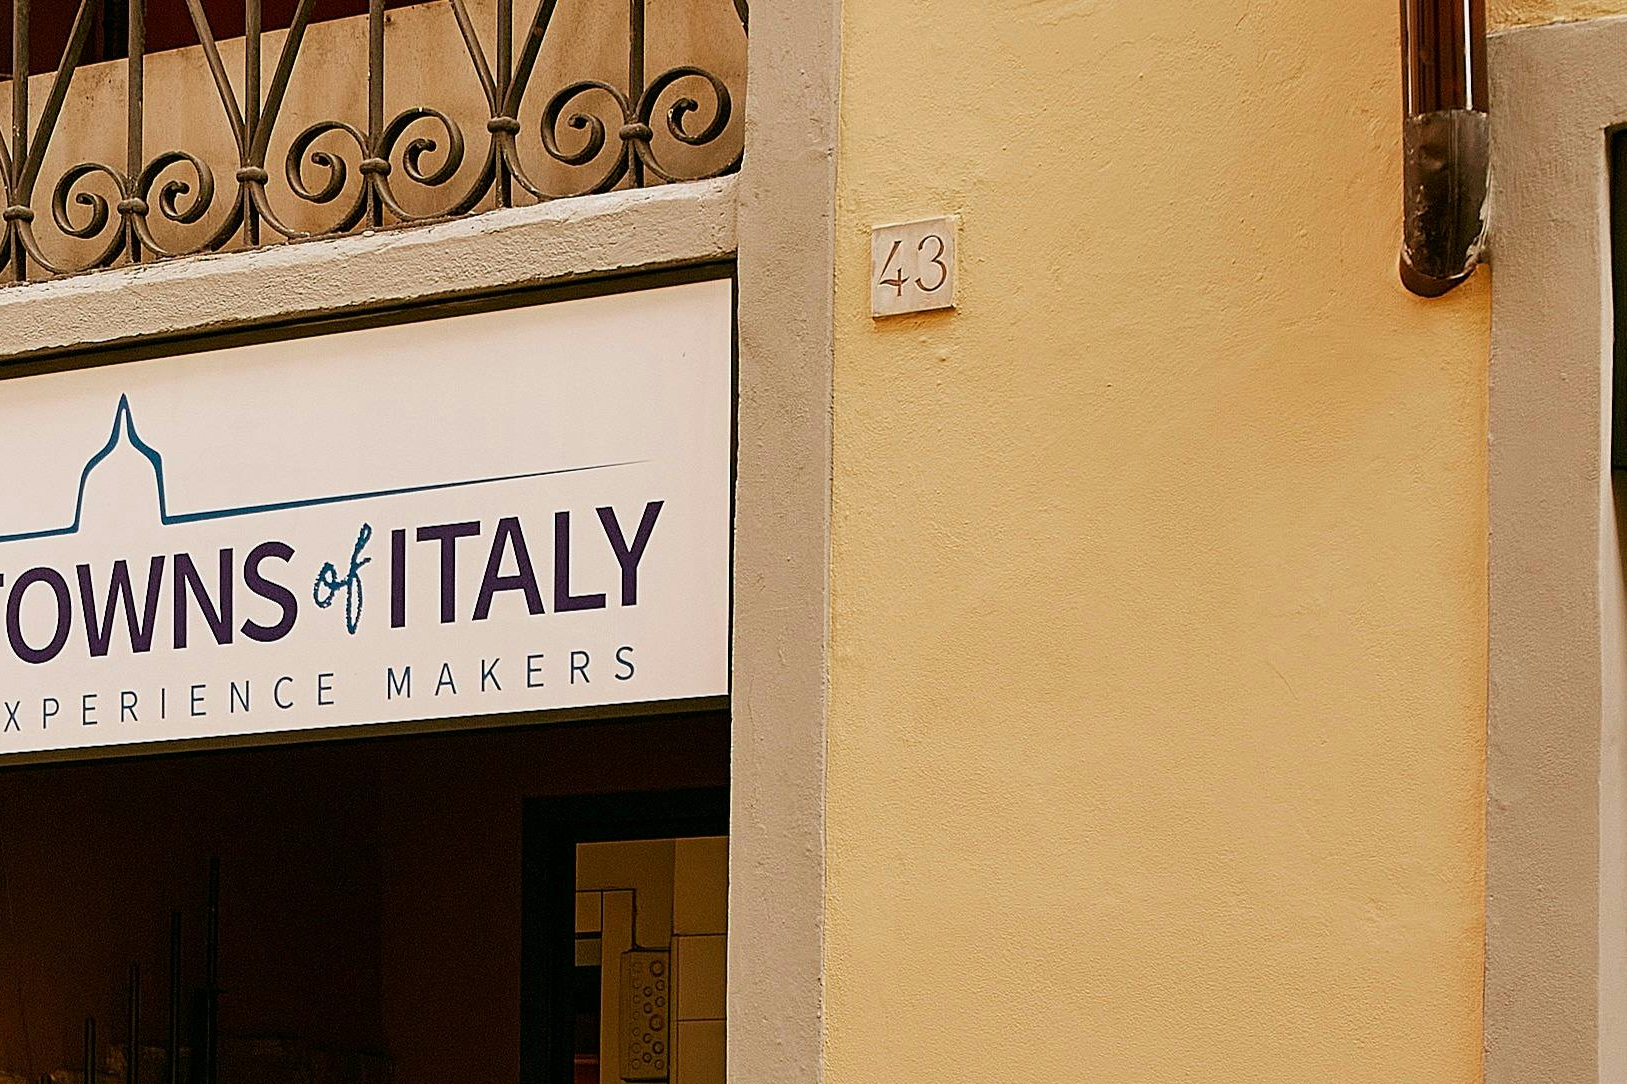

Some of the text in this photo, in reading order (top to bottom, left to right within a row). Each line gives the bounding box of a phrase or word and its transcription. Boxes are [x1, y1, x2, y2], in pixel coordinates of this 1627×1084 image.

[878, 234, 948, 297] 43
[312, 522, 373, 636] of
[390, 500, 665, 629] ITALY
[387, 646, 636, 700] MAKERS
